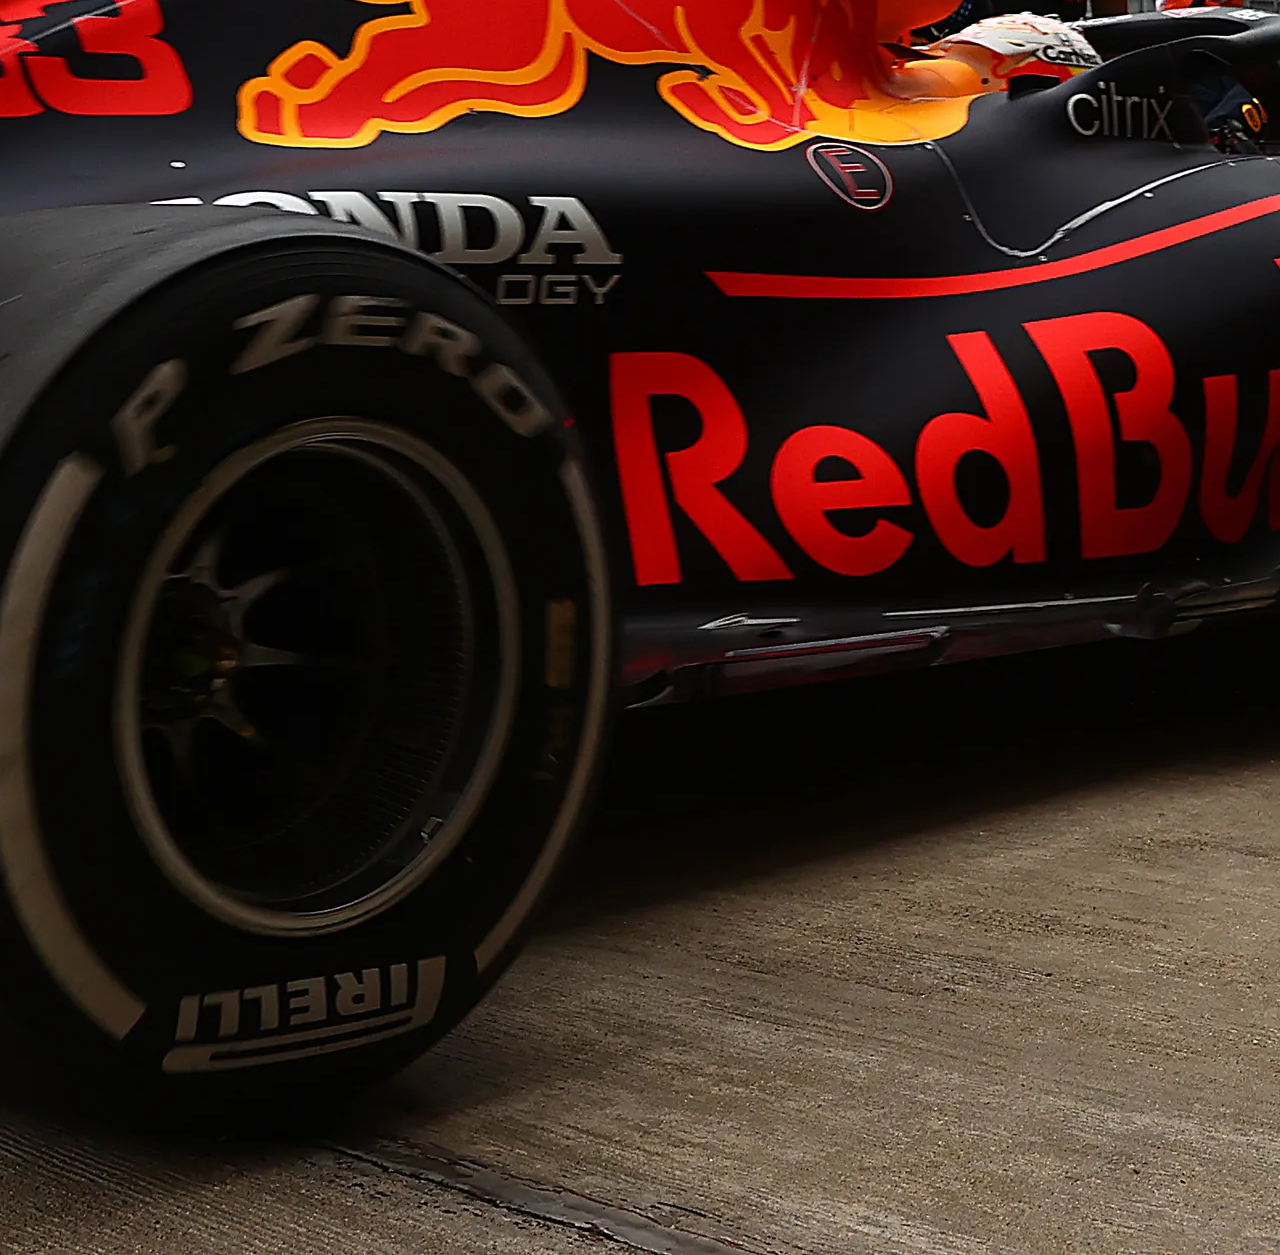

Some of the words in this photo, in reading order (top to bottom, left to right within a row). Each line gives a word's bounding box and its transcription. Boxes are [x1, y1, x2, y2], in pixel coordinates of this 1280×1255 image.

[1065, 80, 1174, 140] citrix
[230, 292, 555, 438] ZERO
[161, 954, 447, 1074] PIRELLI
